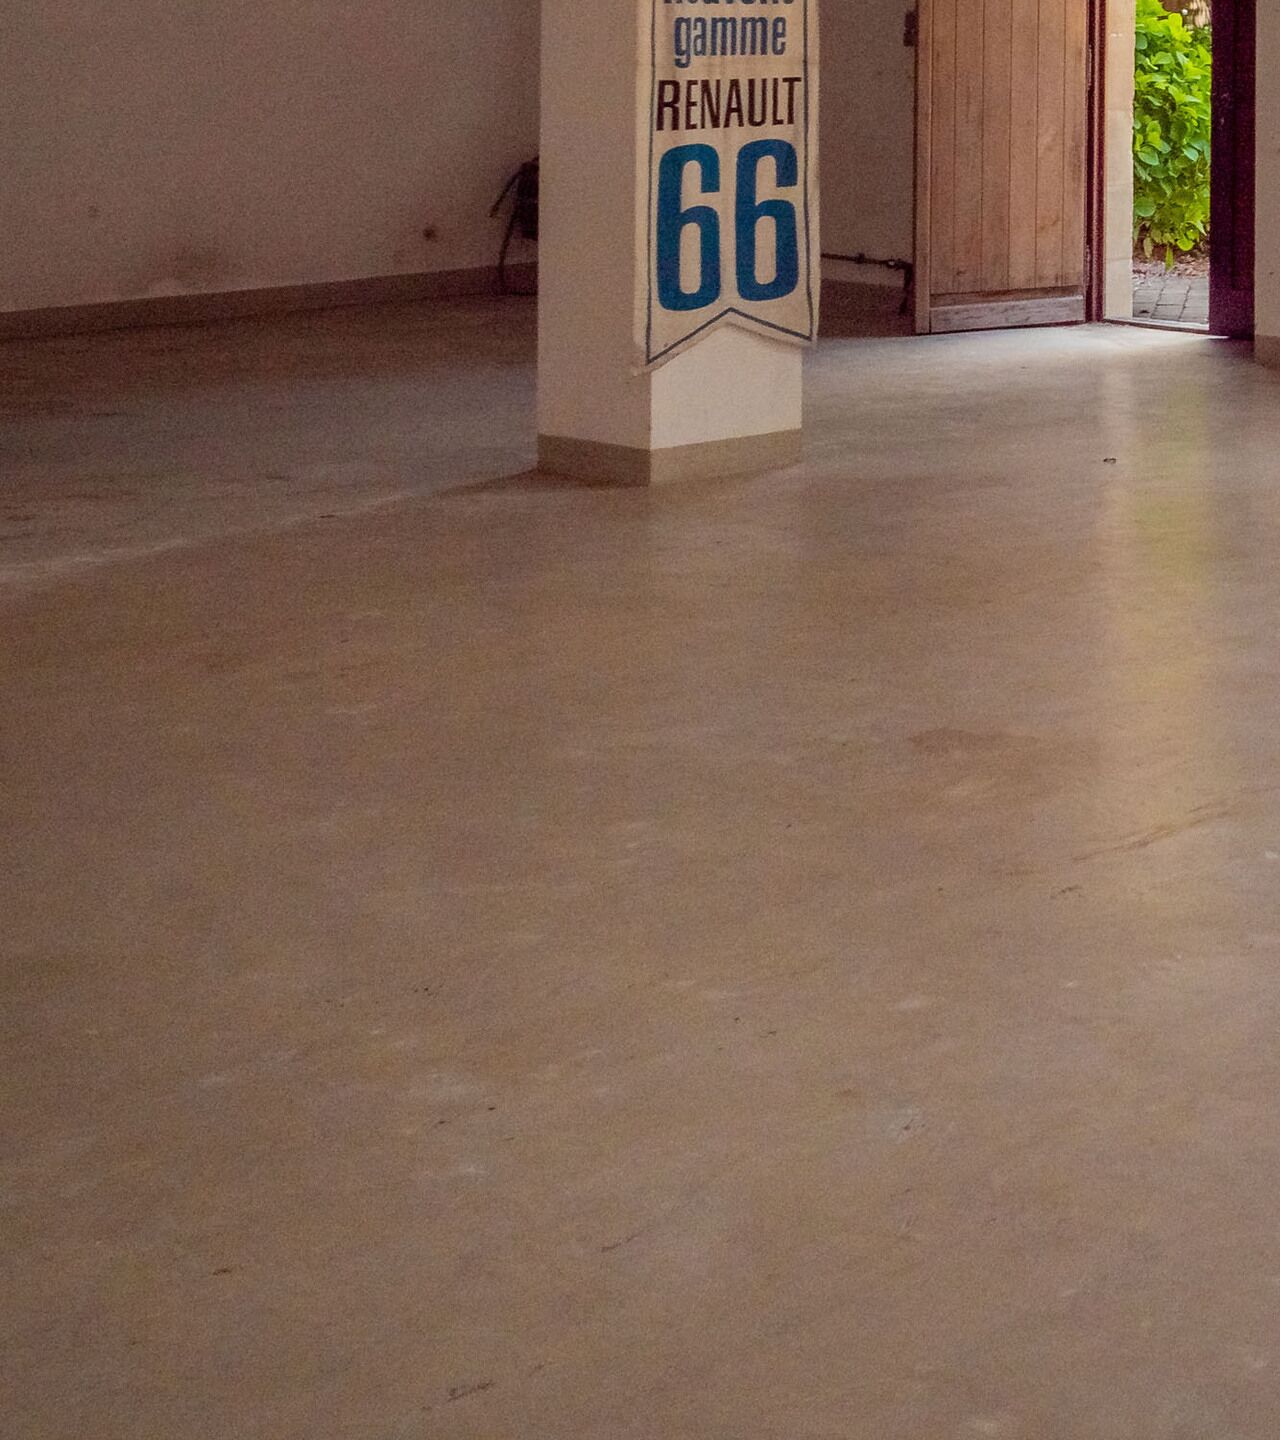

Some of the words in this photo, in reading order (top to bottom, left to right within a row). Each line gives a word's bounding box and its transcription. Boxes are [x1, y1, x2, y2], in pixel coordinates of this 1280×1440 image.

[673, 14, 787, 69] gamme
[656, 76, 802, 132] RENAULT
[656, 138, 799, 311] 66
